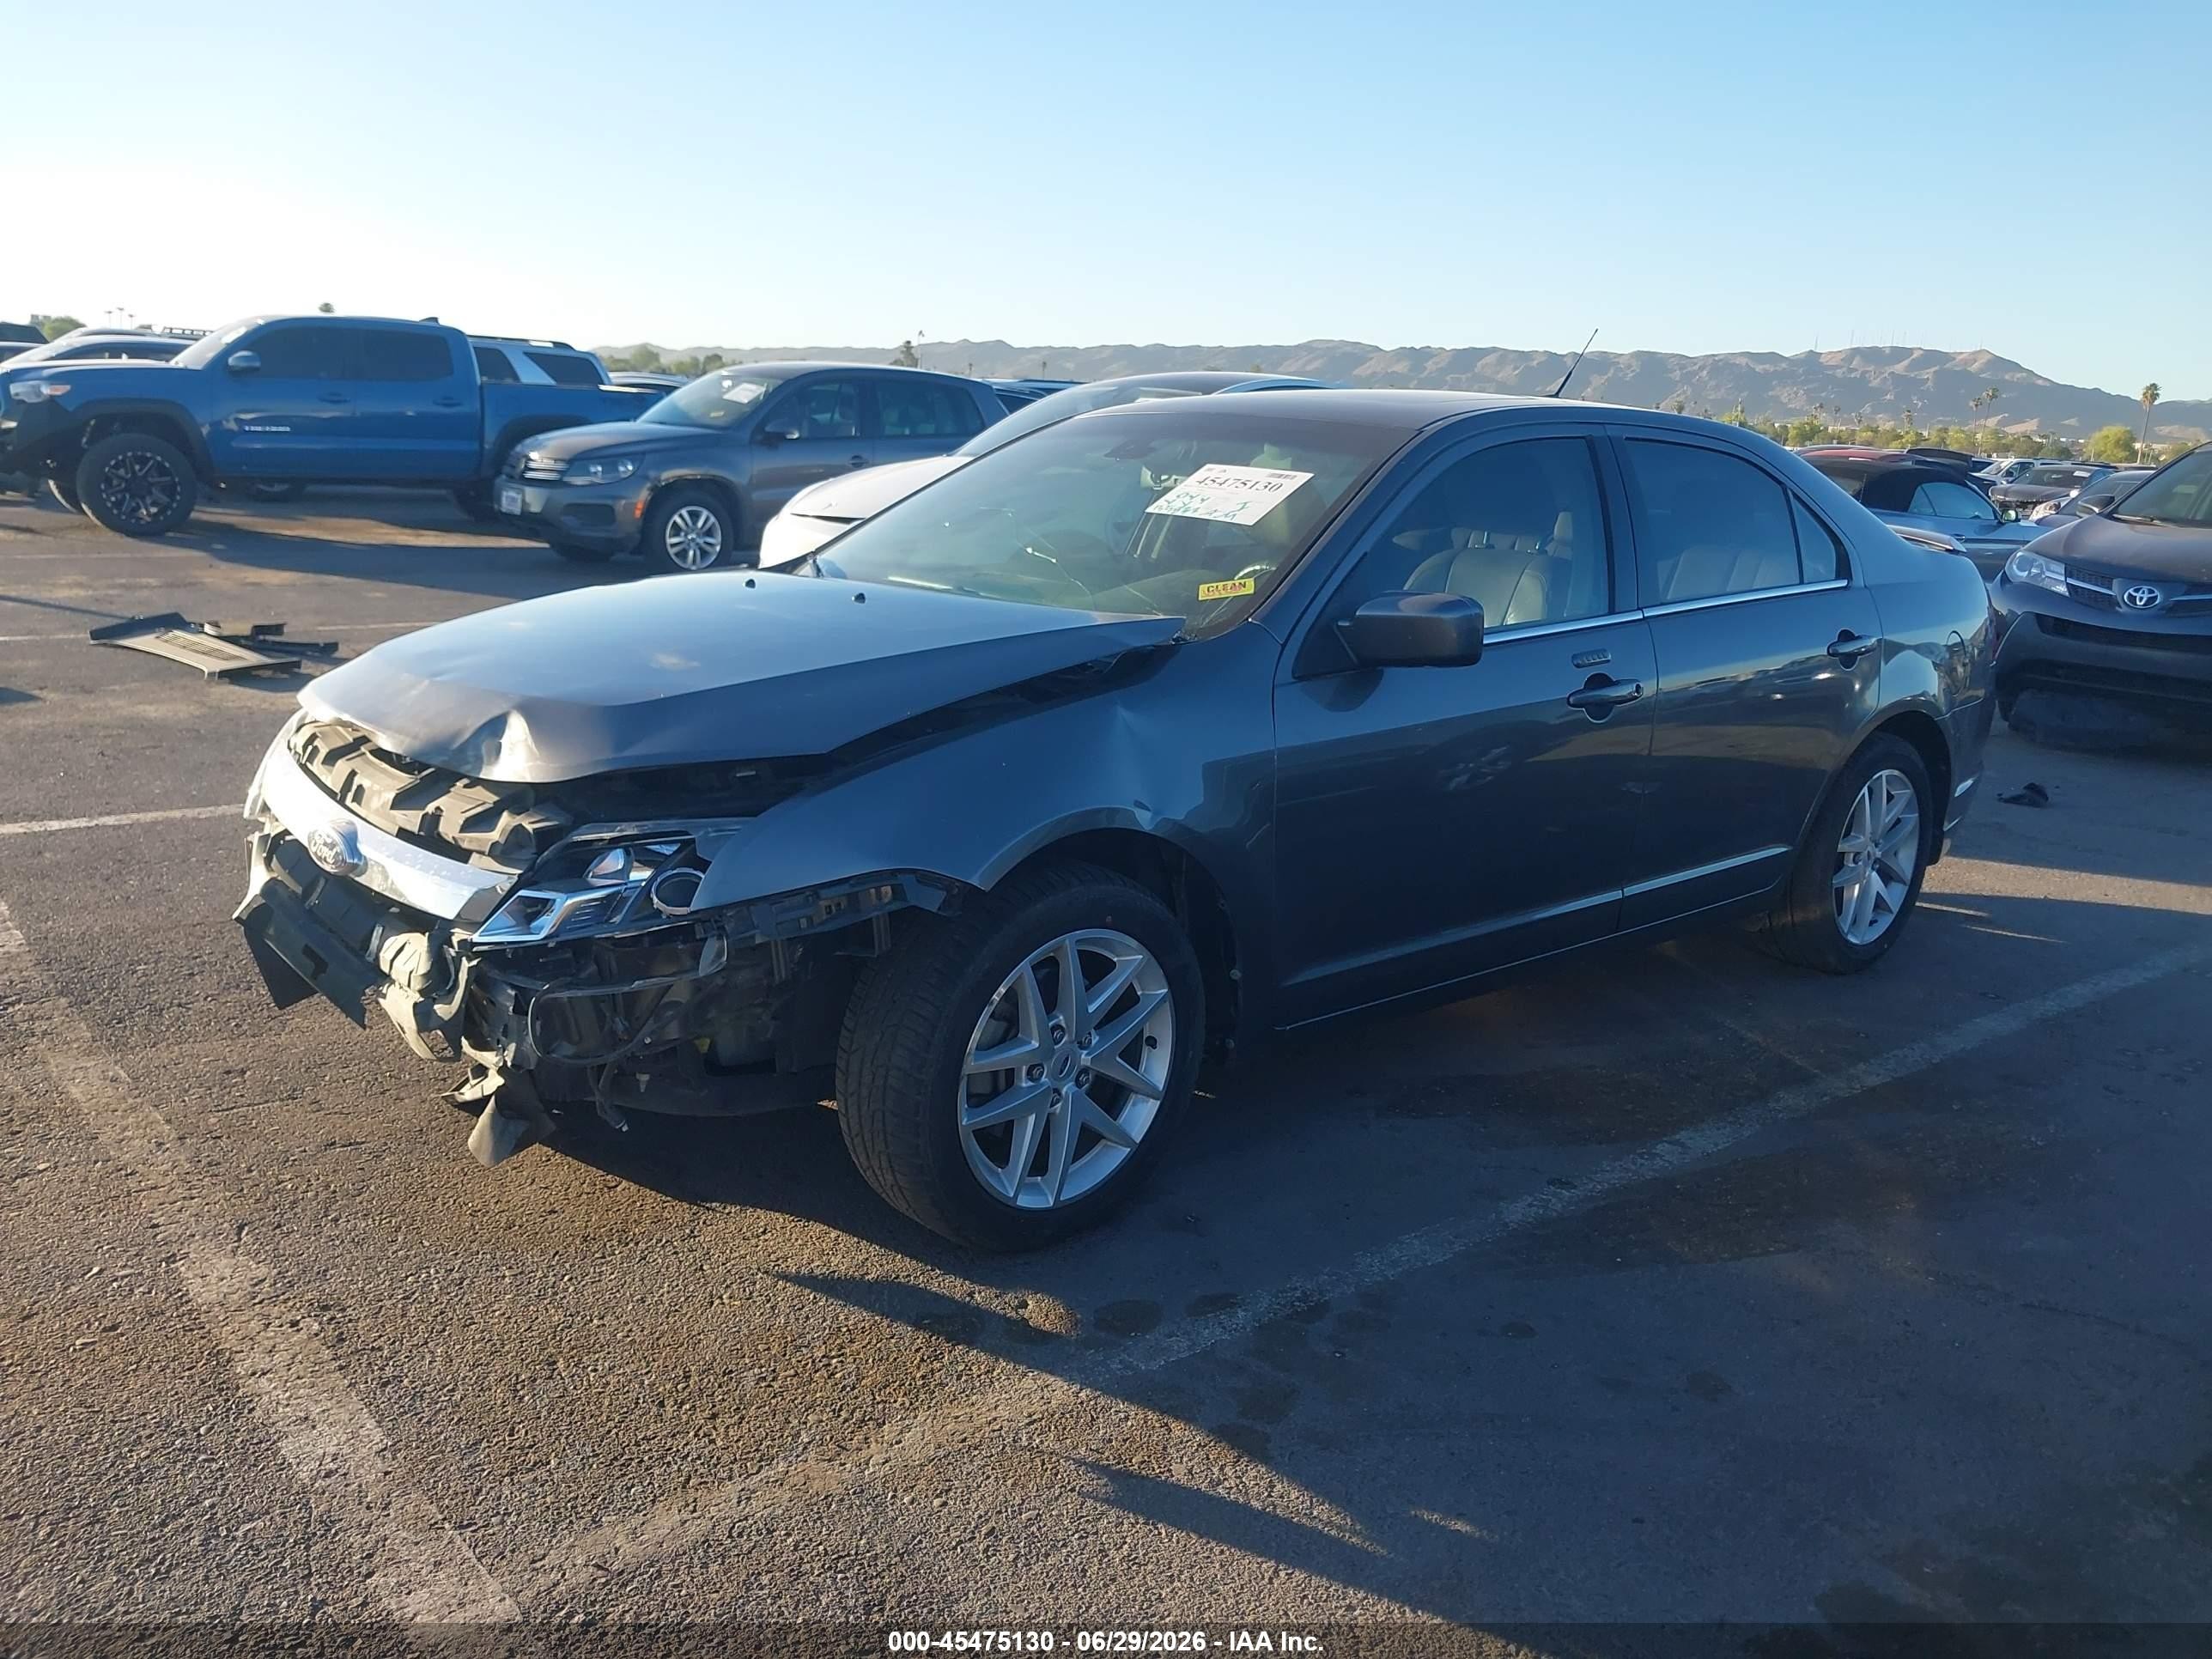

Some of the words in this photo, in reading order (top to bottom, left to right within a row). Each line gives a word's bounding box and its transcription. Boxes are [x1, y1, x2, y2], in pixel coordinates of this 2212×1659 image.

[1196, 476, 1283, 492] 45475130
[1206, 581, 1247, 593] CLEAN
[310, 831, 340, 864] Ford
